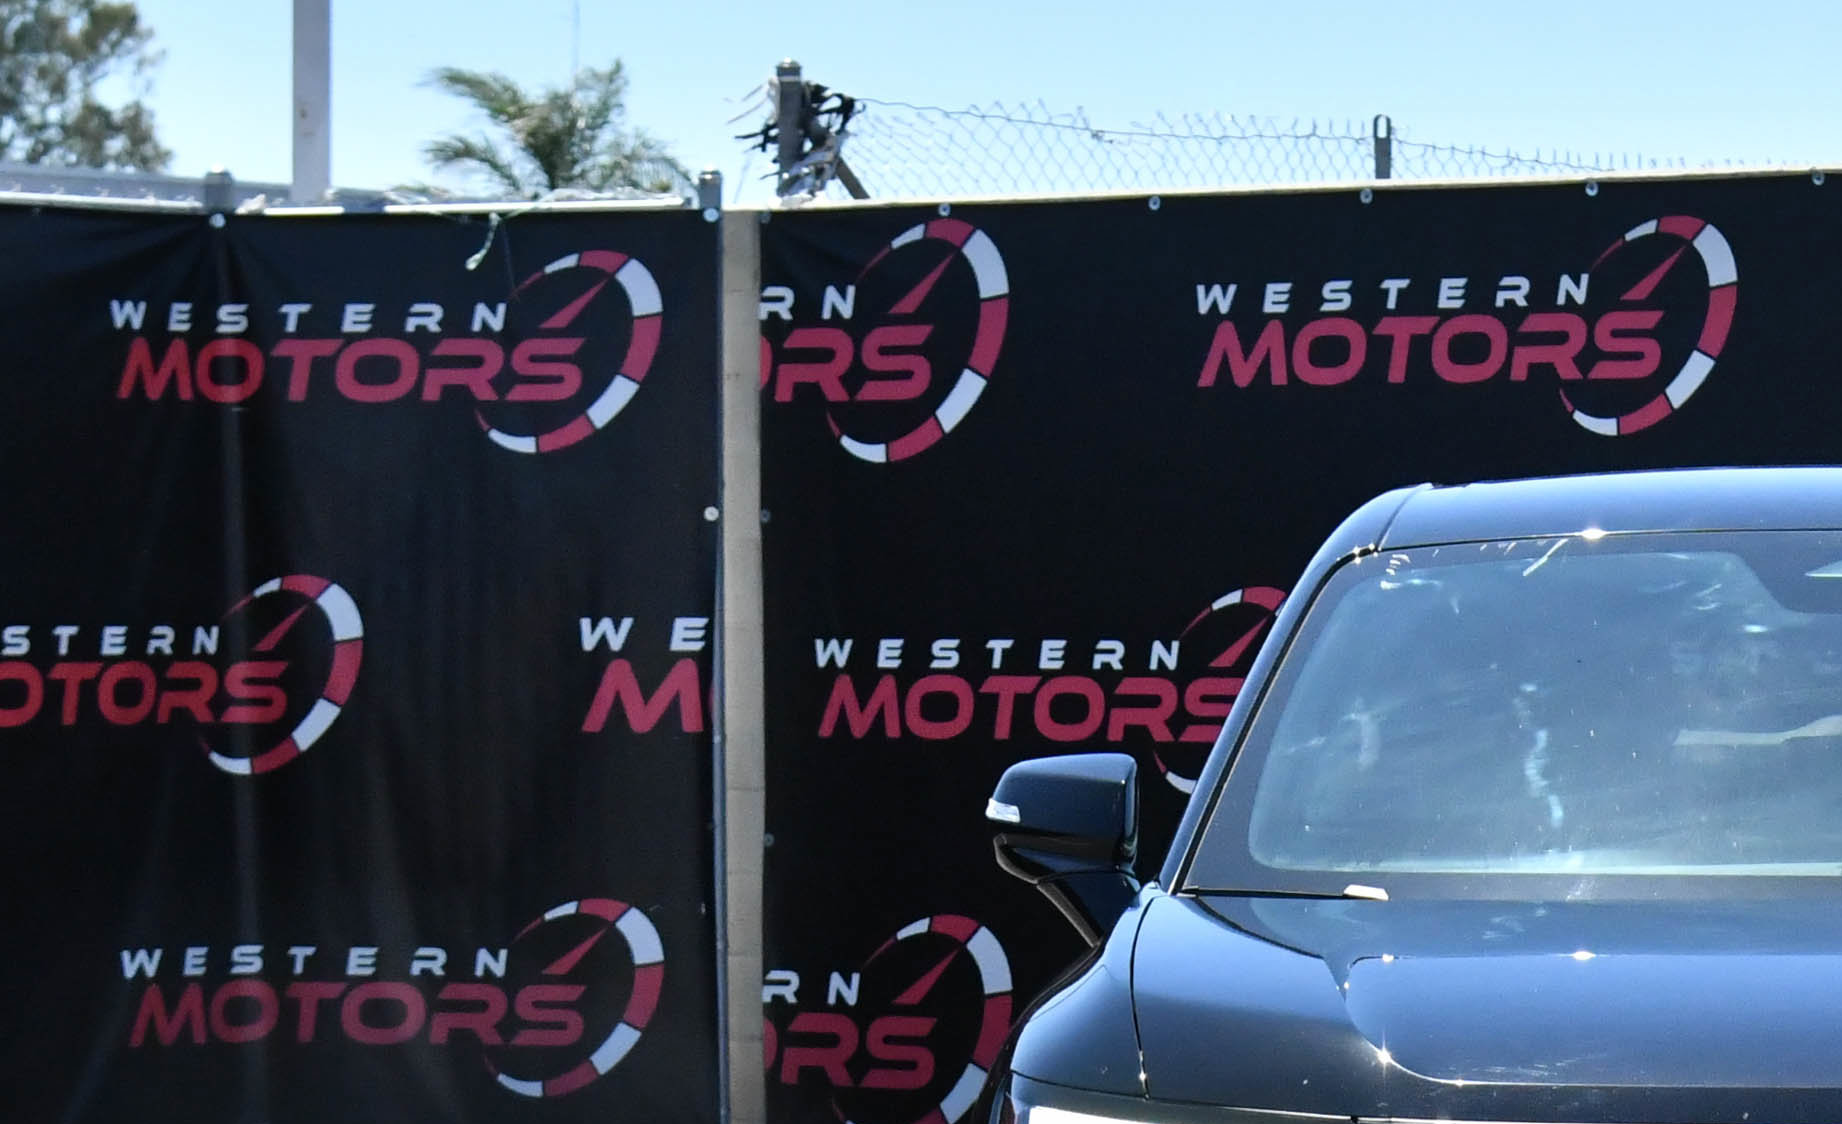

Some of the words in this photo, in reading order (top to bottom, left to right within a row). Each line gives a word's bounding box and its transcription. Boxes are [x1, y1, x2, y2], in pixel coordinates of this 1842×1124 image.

[1195, 272, 1591, 316] WESTERN
[111, 299, 508, 334] WESTERN
[1198, 309, 1664, 389] MOTORS
[117, 336, 584, 402] MOTORS
[0, 624, 220, 657] STERN
[578, 616, 710, 653] WE
[814, 637, 1181, 671] WESTERN
[818, 673, 1246, 743] MOTORS
[122, 945, 508, 979] WESTERN
[762, 969, 861, 1006] RN
[132, 982, 586, 1046] MOTORS
